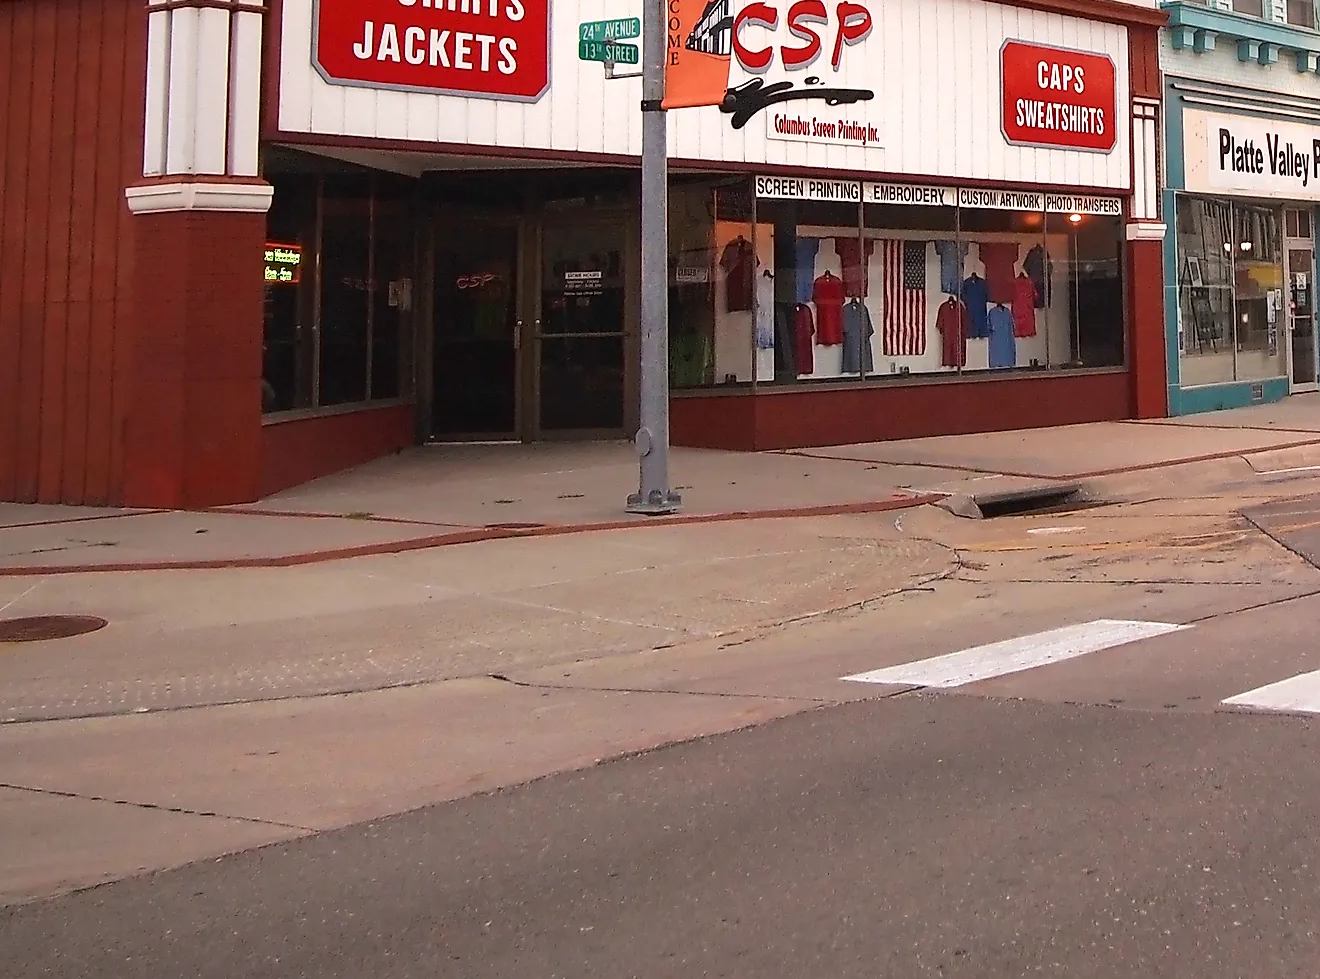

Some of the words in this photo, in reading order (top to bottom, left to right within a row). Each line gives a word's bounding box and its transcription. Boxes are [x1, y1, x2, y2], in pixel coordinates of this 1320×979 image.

[604, 20, 637, 38] AVENUE
[732, 0, 874, 75] CSP
[353, 20, 518, 75] JACKETS
[605, 44, 636, 62] STREET
[1037, 60, 1085, 94] CAPS
[774, 113, 811, 136] Columbus
[812, 116, 836, 139] Screen
[838, 119, 867, 146] Printing
[867, 122, 880, 143] Inc.
[1016, 98, 1105, 136] SWEATSHIRTS
[1219, 127, 1264, 174] Platte
[1266, 132, 1310, 188] Valley
[757, 177, 804, 197] SCREEN
[809, 180, 859, 200] PRINTING
[873, 185, 945, 204] EMBROIDERY
[960, 189, 997, 206] CUSTOM
[999, 191, 1041, 210] ARTWORK
[1046, 195, 1072, 211] PHOTO
[1073, 197, 1120, 214] TRANSFERS
